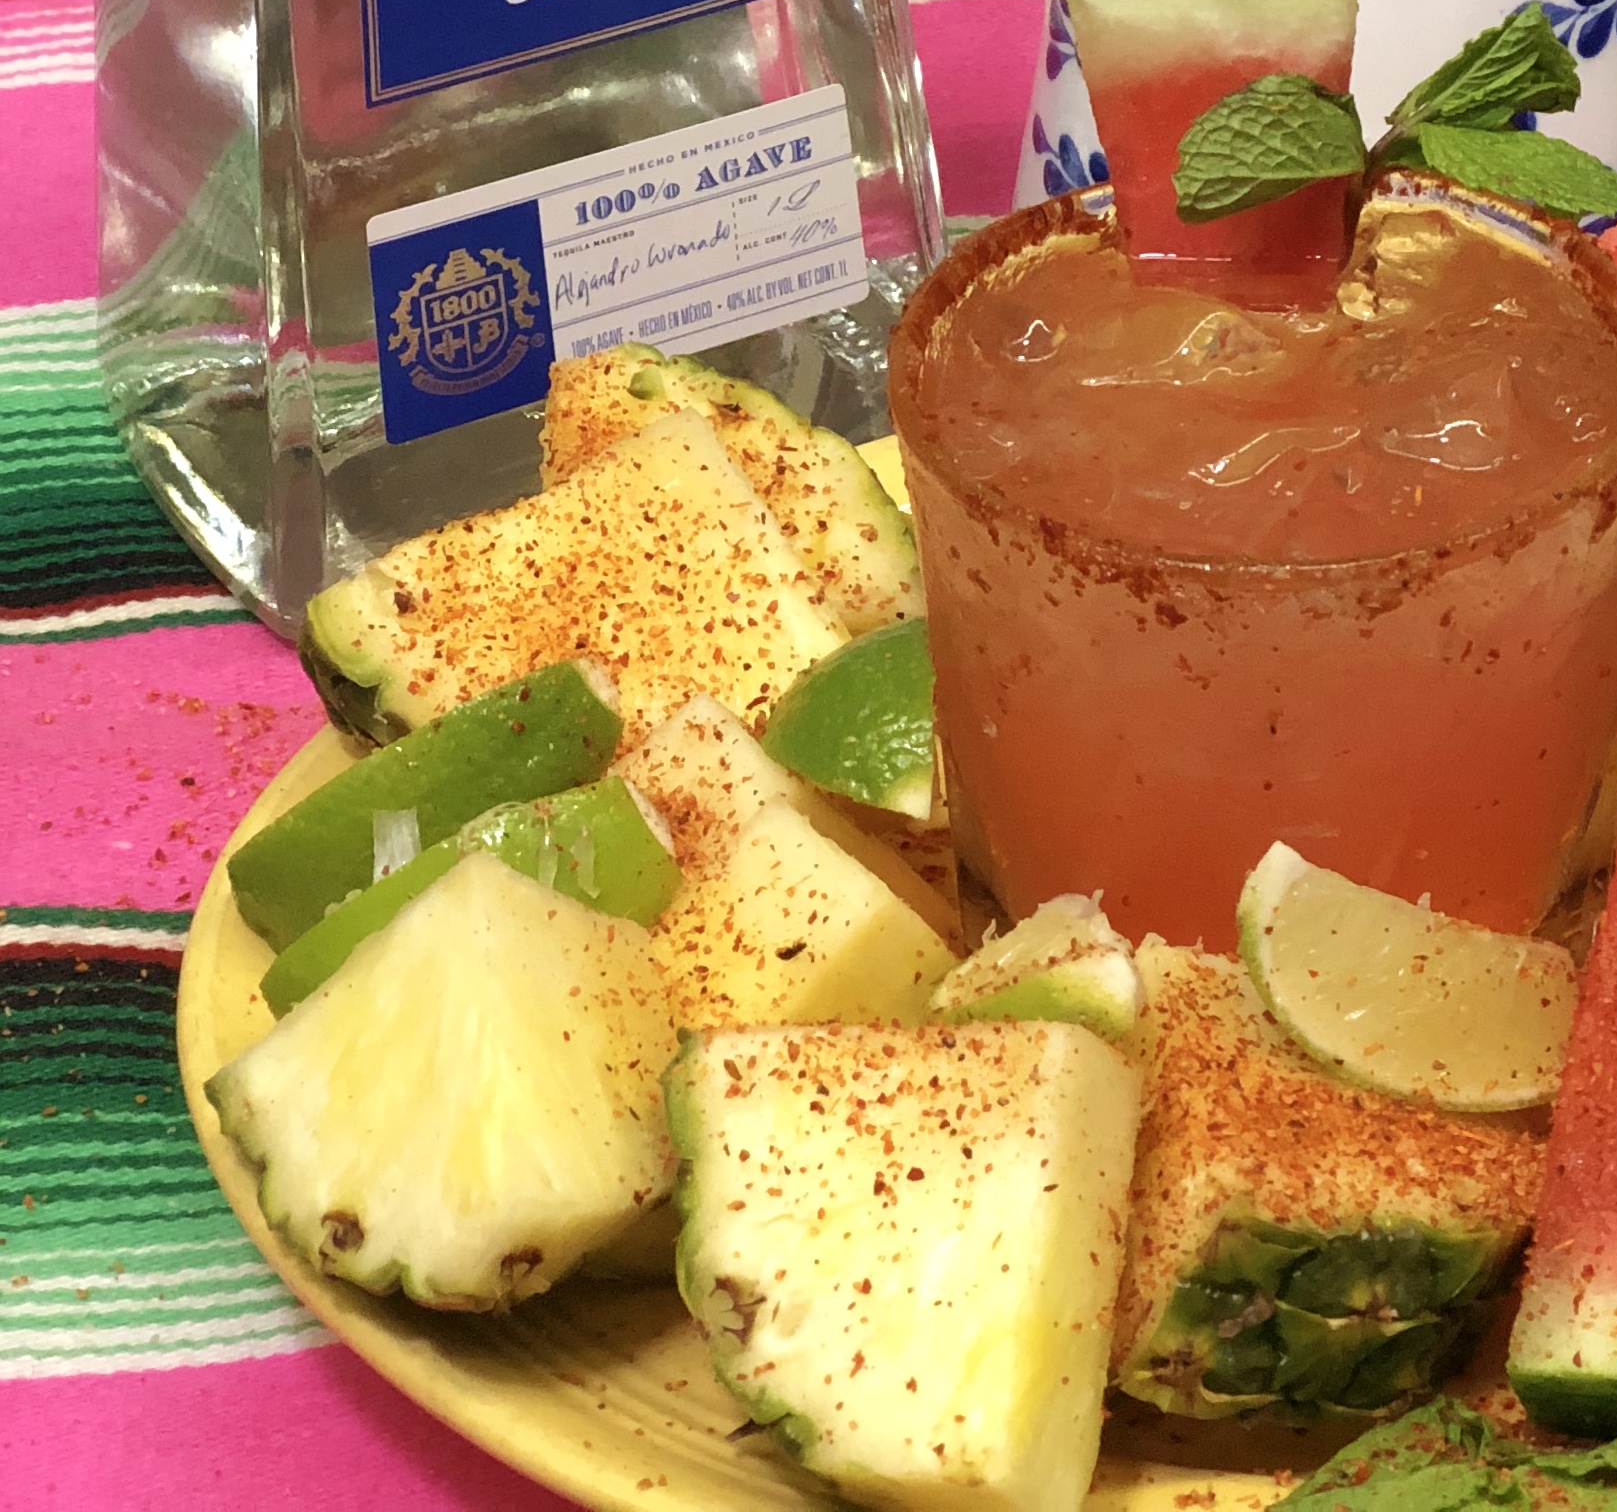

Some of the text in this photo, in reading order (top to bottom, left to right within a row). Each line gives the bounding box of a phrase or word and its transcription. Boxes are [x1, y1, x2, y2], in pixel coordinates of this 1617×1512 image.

[628, 154, 675, 175] HECHO
[681, 147, 699, 160] EN
[574, 136, 813, 226] 100% AGAVE
[553, 243, 591, 259] TEQUILA
[429, 284, 497, 324] 1800
[597, 326, 624, 349] AGAVE
[638, 314, 666, 338] HECHO
[667, 310, 680, 329] EN
